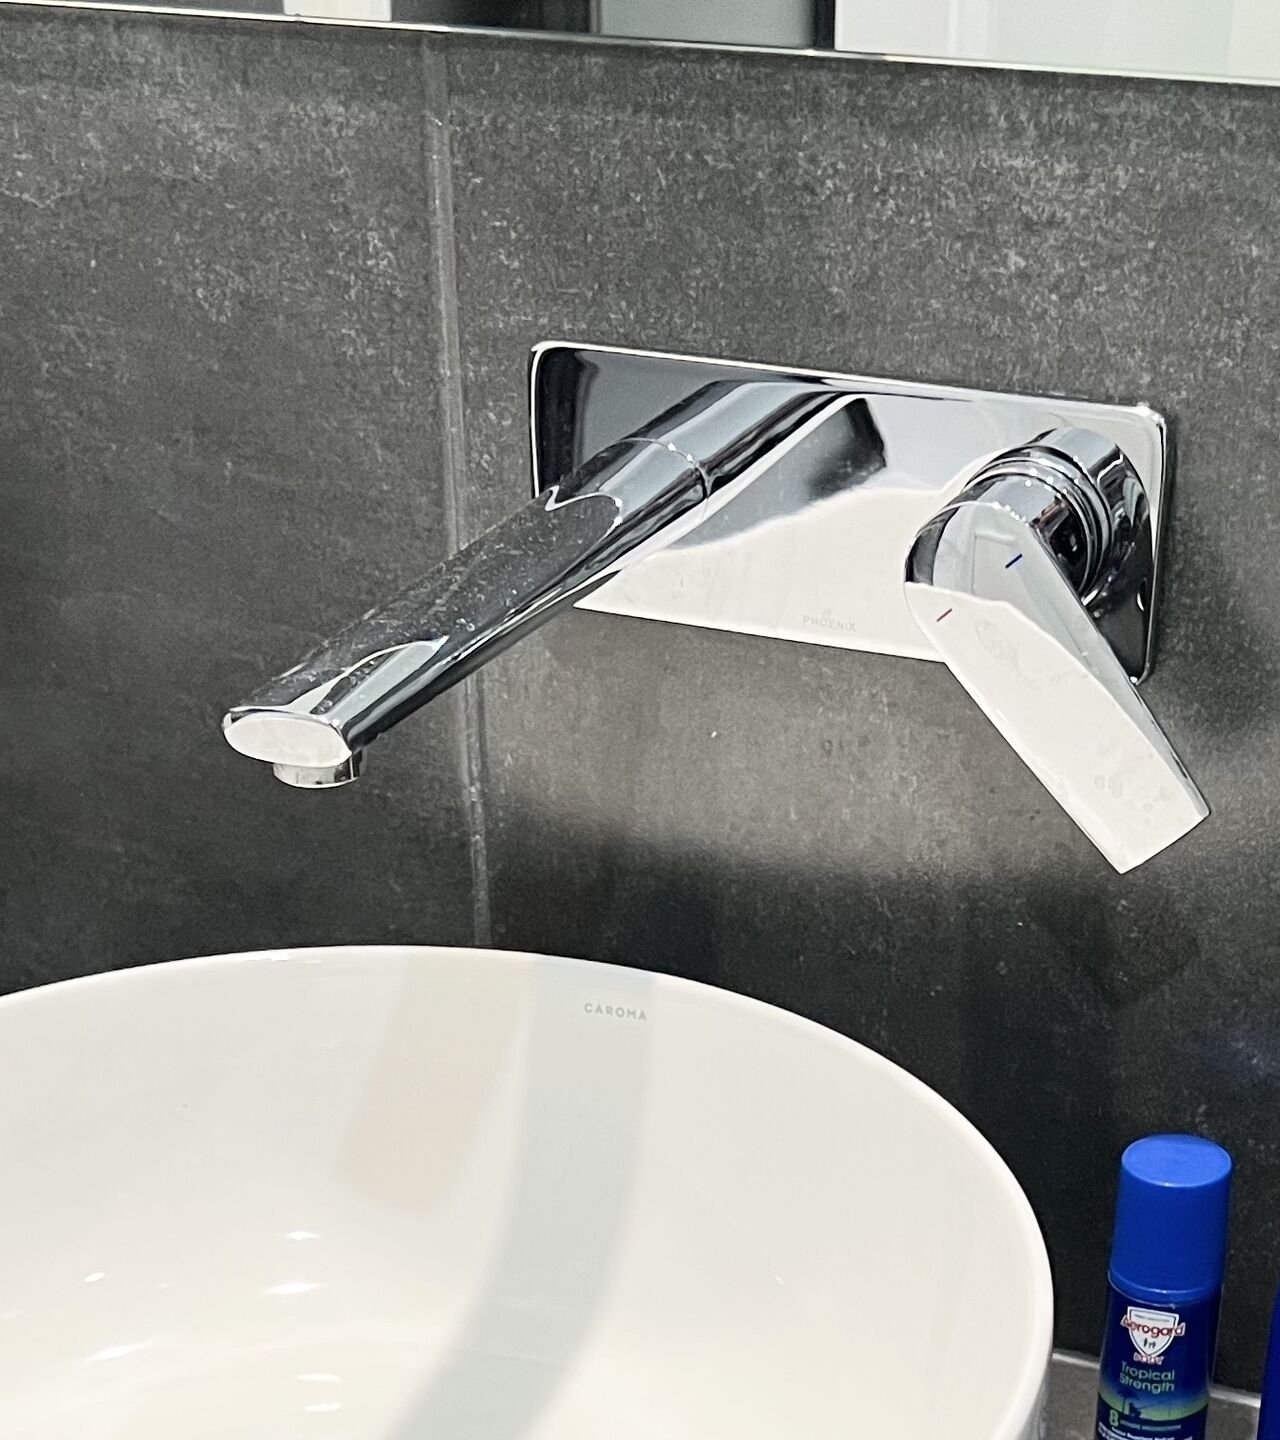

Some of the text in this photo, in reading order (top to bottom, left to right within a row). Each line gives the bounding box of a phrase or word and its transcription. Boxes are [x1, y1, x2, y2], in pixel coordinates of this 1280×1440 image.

[802, 615, 856, 632] PHOENIX
[584, 1002, 647, 1021] CAROMA
[1120, 1314, 1186, 1339] Aerogard
[1121, 1361, 1175, 1380] Tropical
[1120, 1372, 1175, 1395] Strength
